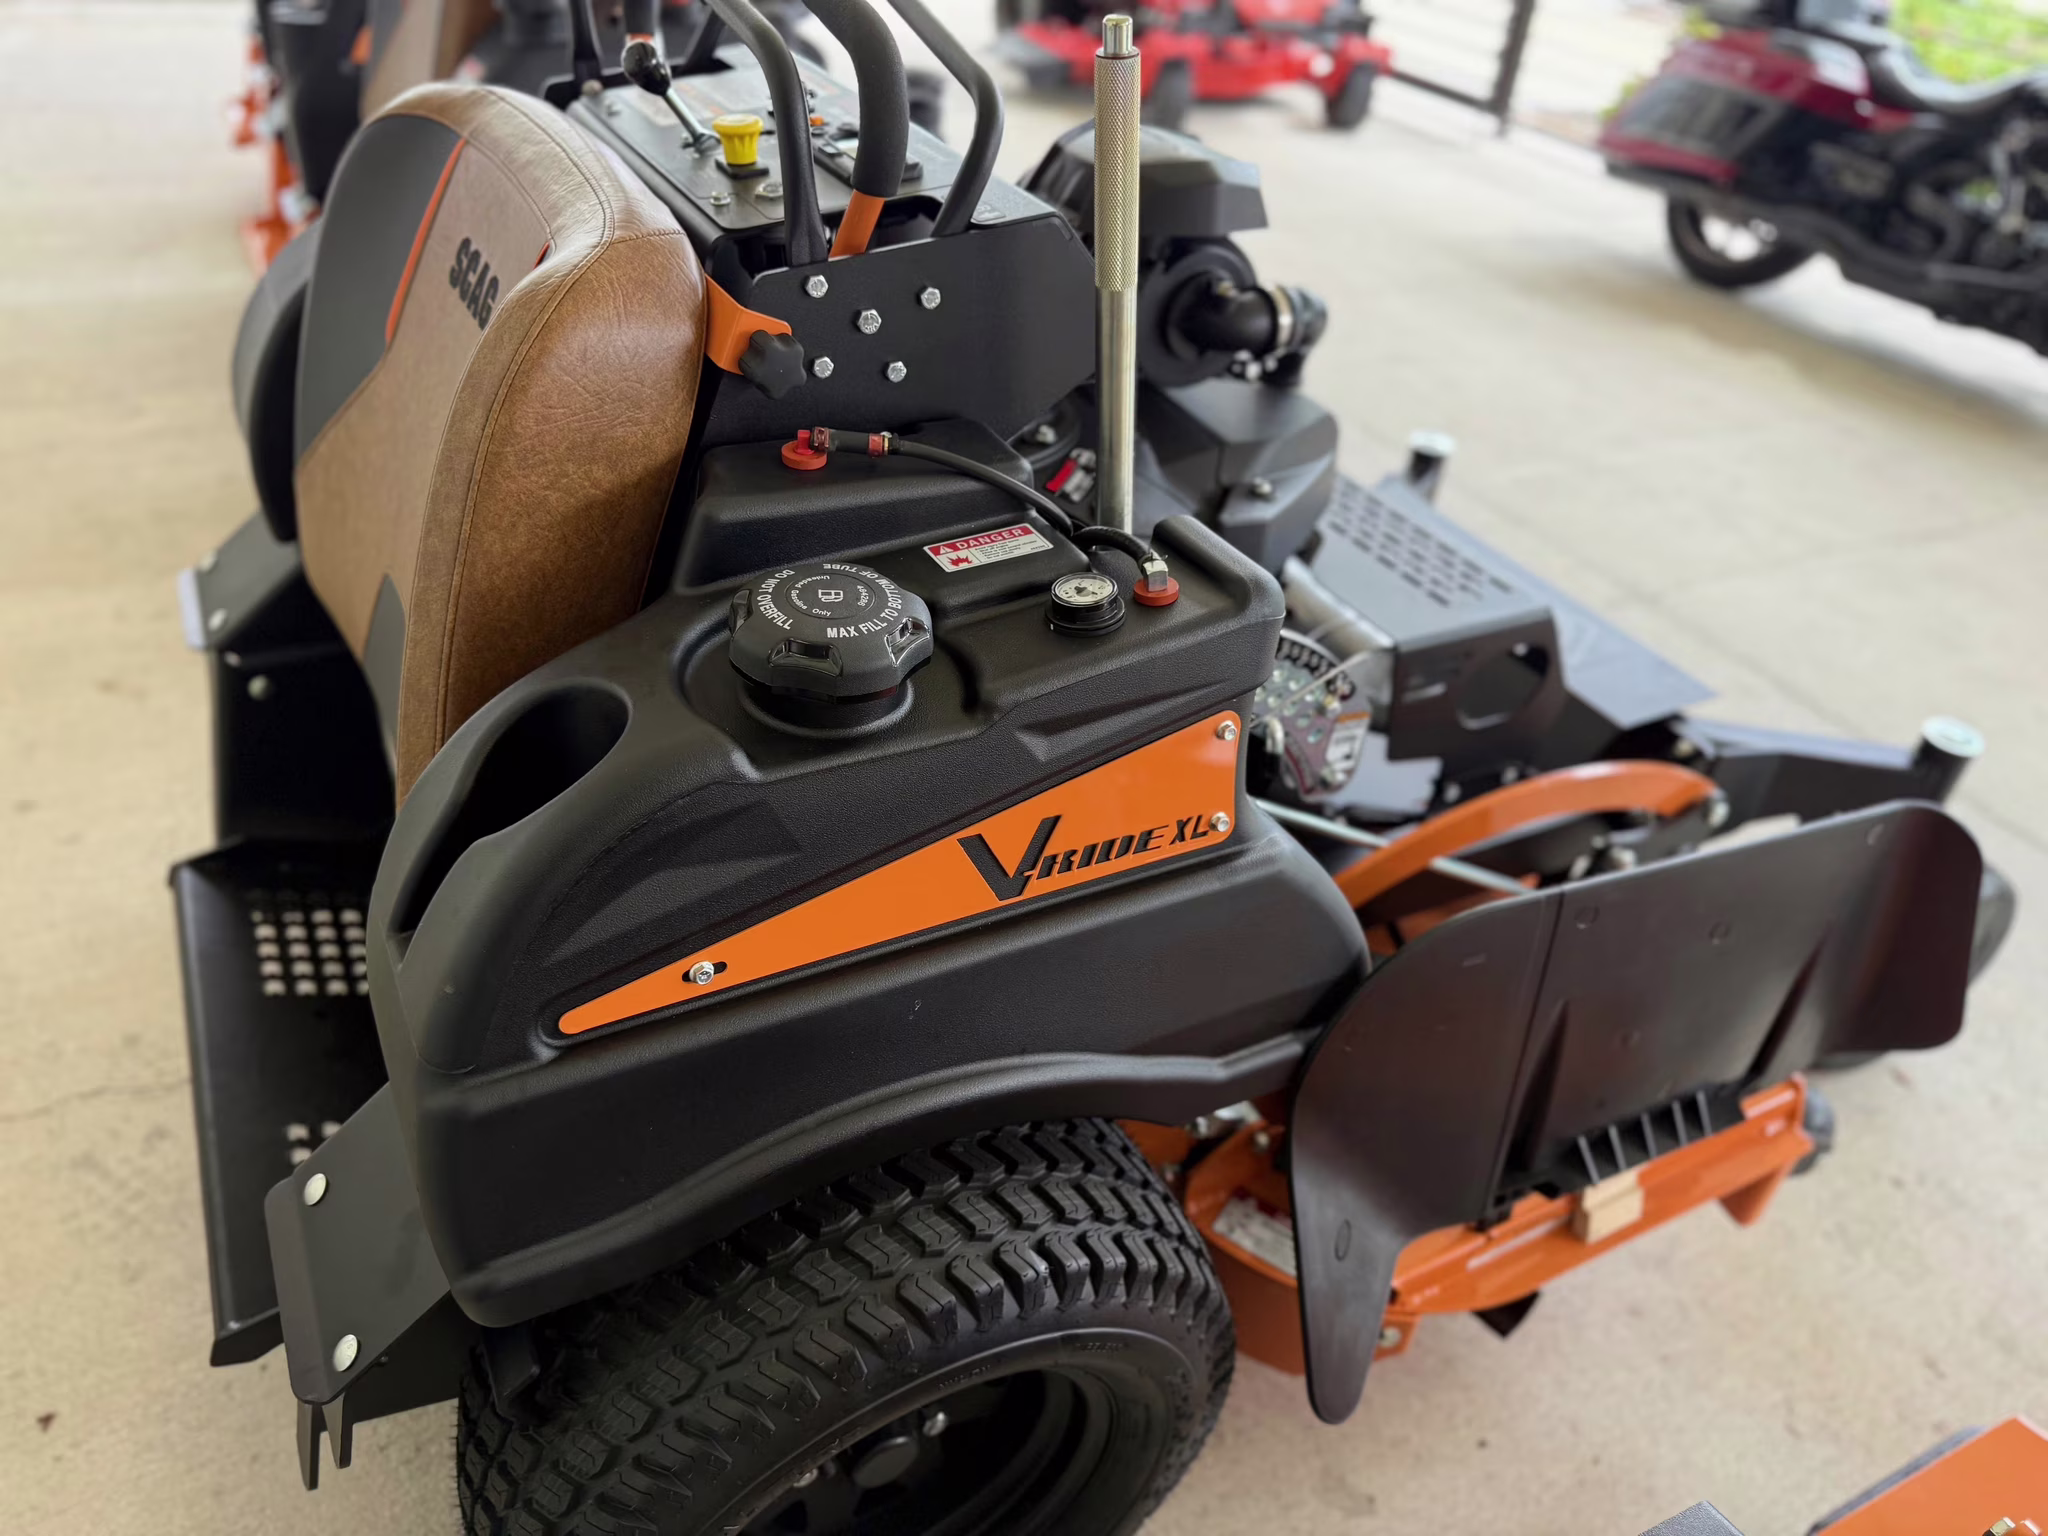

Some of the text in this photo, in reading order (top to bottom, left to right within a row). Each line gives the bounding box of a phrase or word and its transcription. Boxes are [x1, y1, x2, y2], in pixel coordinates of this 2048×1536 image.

[448, 236, 500, 331] SCAG
[956, 528, 1025, 549] DANGER
[756, 569, 796, 630] DO NOT OVERFILL
[790, 575, 832, 617] Unleaded Gasoline Only
[822, 563, 903, 638] MAX FILL TO BOTTOM OF TUBE
[1168, 814, 1211, 846] XL
